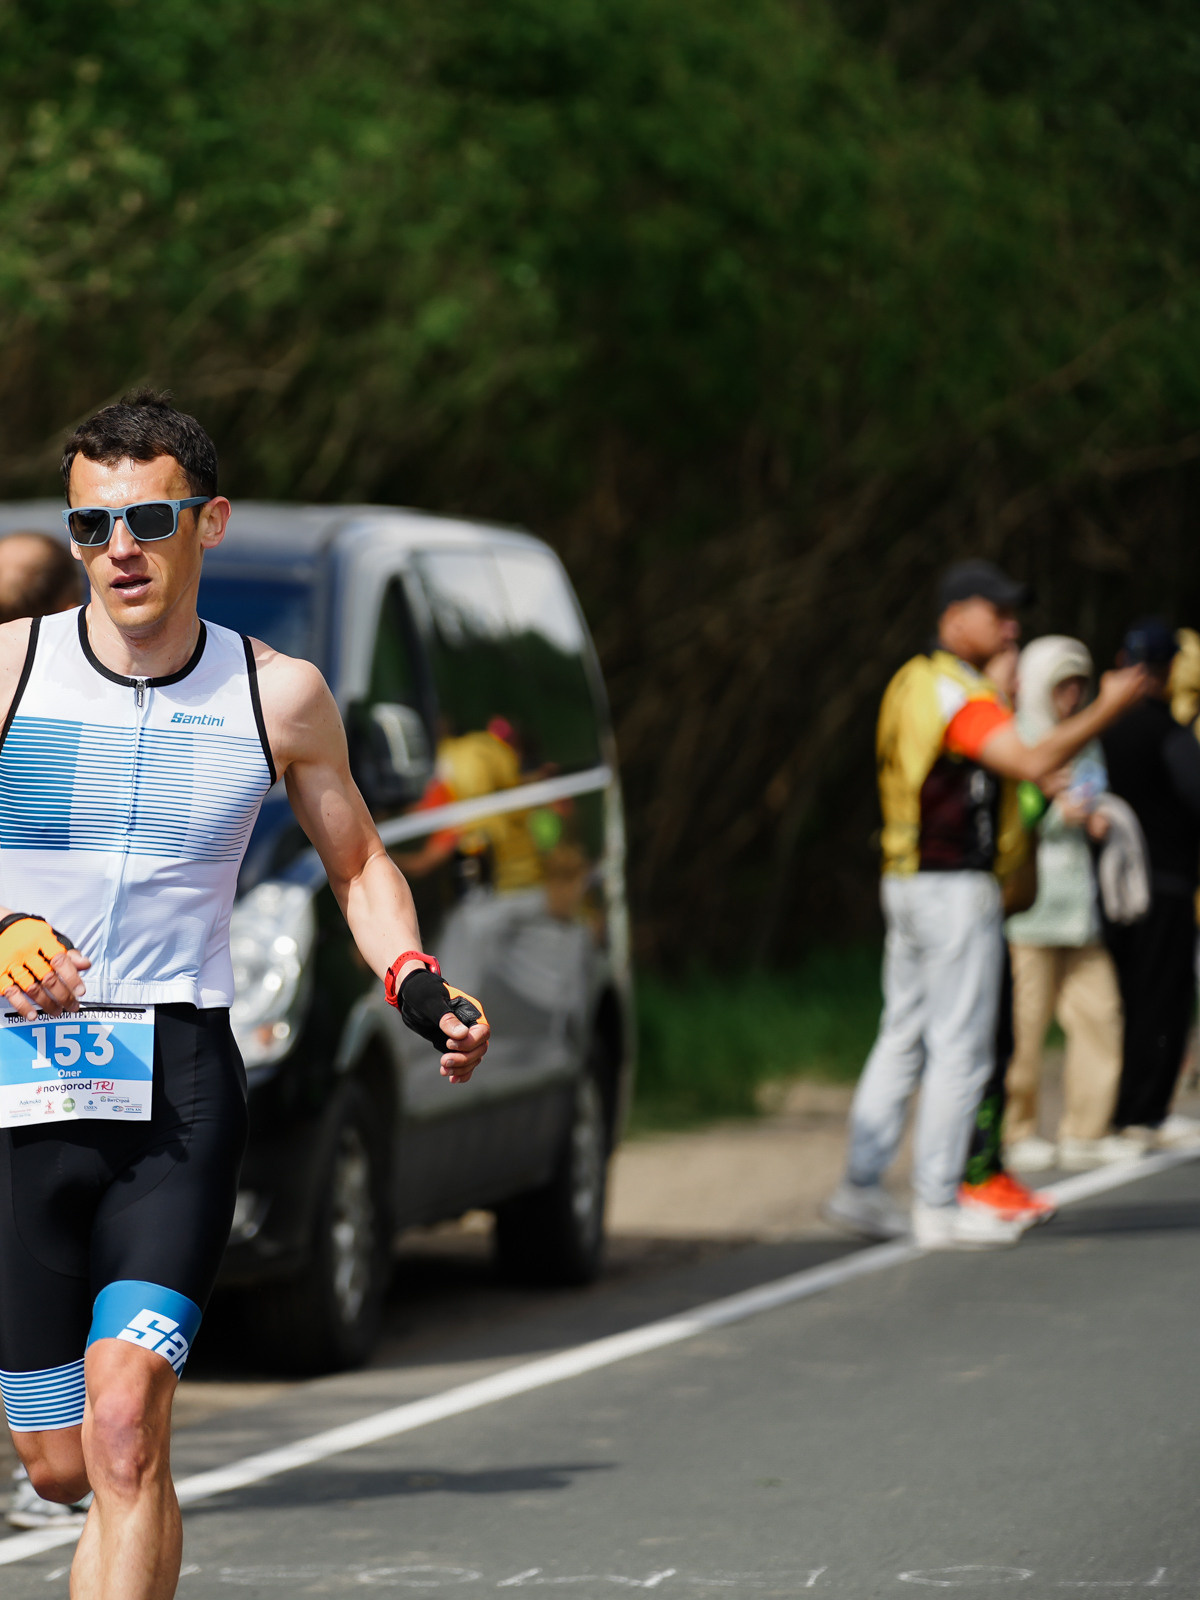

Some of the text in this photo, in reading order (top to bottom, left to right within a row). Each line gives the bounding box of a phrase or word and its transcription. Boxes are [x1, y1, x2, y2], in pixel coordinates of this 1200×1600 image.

[170, 711, 225, 727] Santini
[122, 1011, 143, 1021] 2023
[31, 1024, 115, 1070] 153
[57, 1068, 82, 1079] Олег
